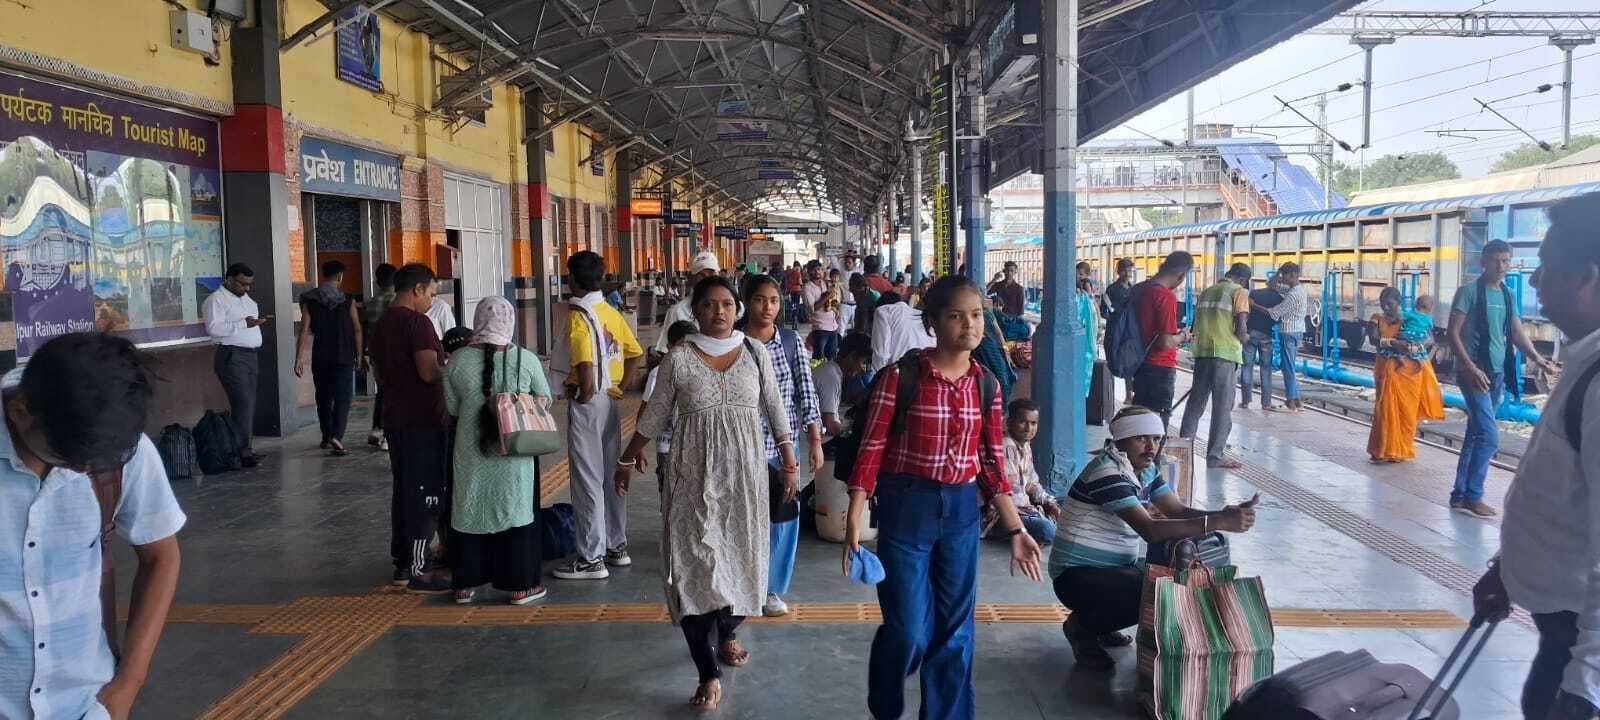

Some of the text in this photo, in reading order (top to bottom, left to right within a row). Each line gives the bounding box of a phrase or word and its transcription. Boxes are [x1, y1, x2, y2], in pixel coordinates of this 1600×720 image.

[0, 88, 206, 157] पर्यटक मानचित्र Tourist Map
[302, 148, 398, 190] प्रवेश ENTRANCE
[35, 320, 66, 337] Railway
[68, 318, 95, 334] Station
